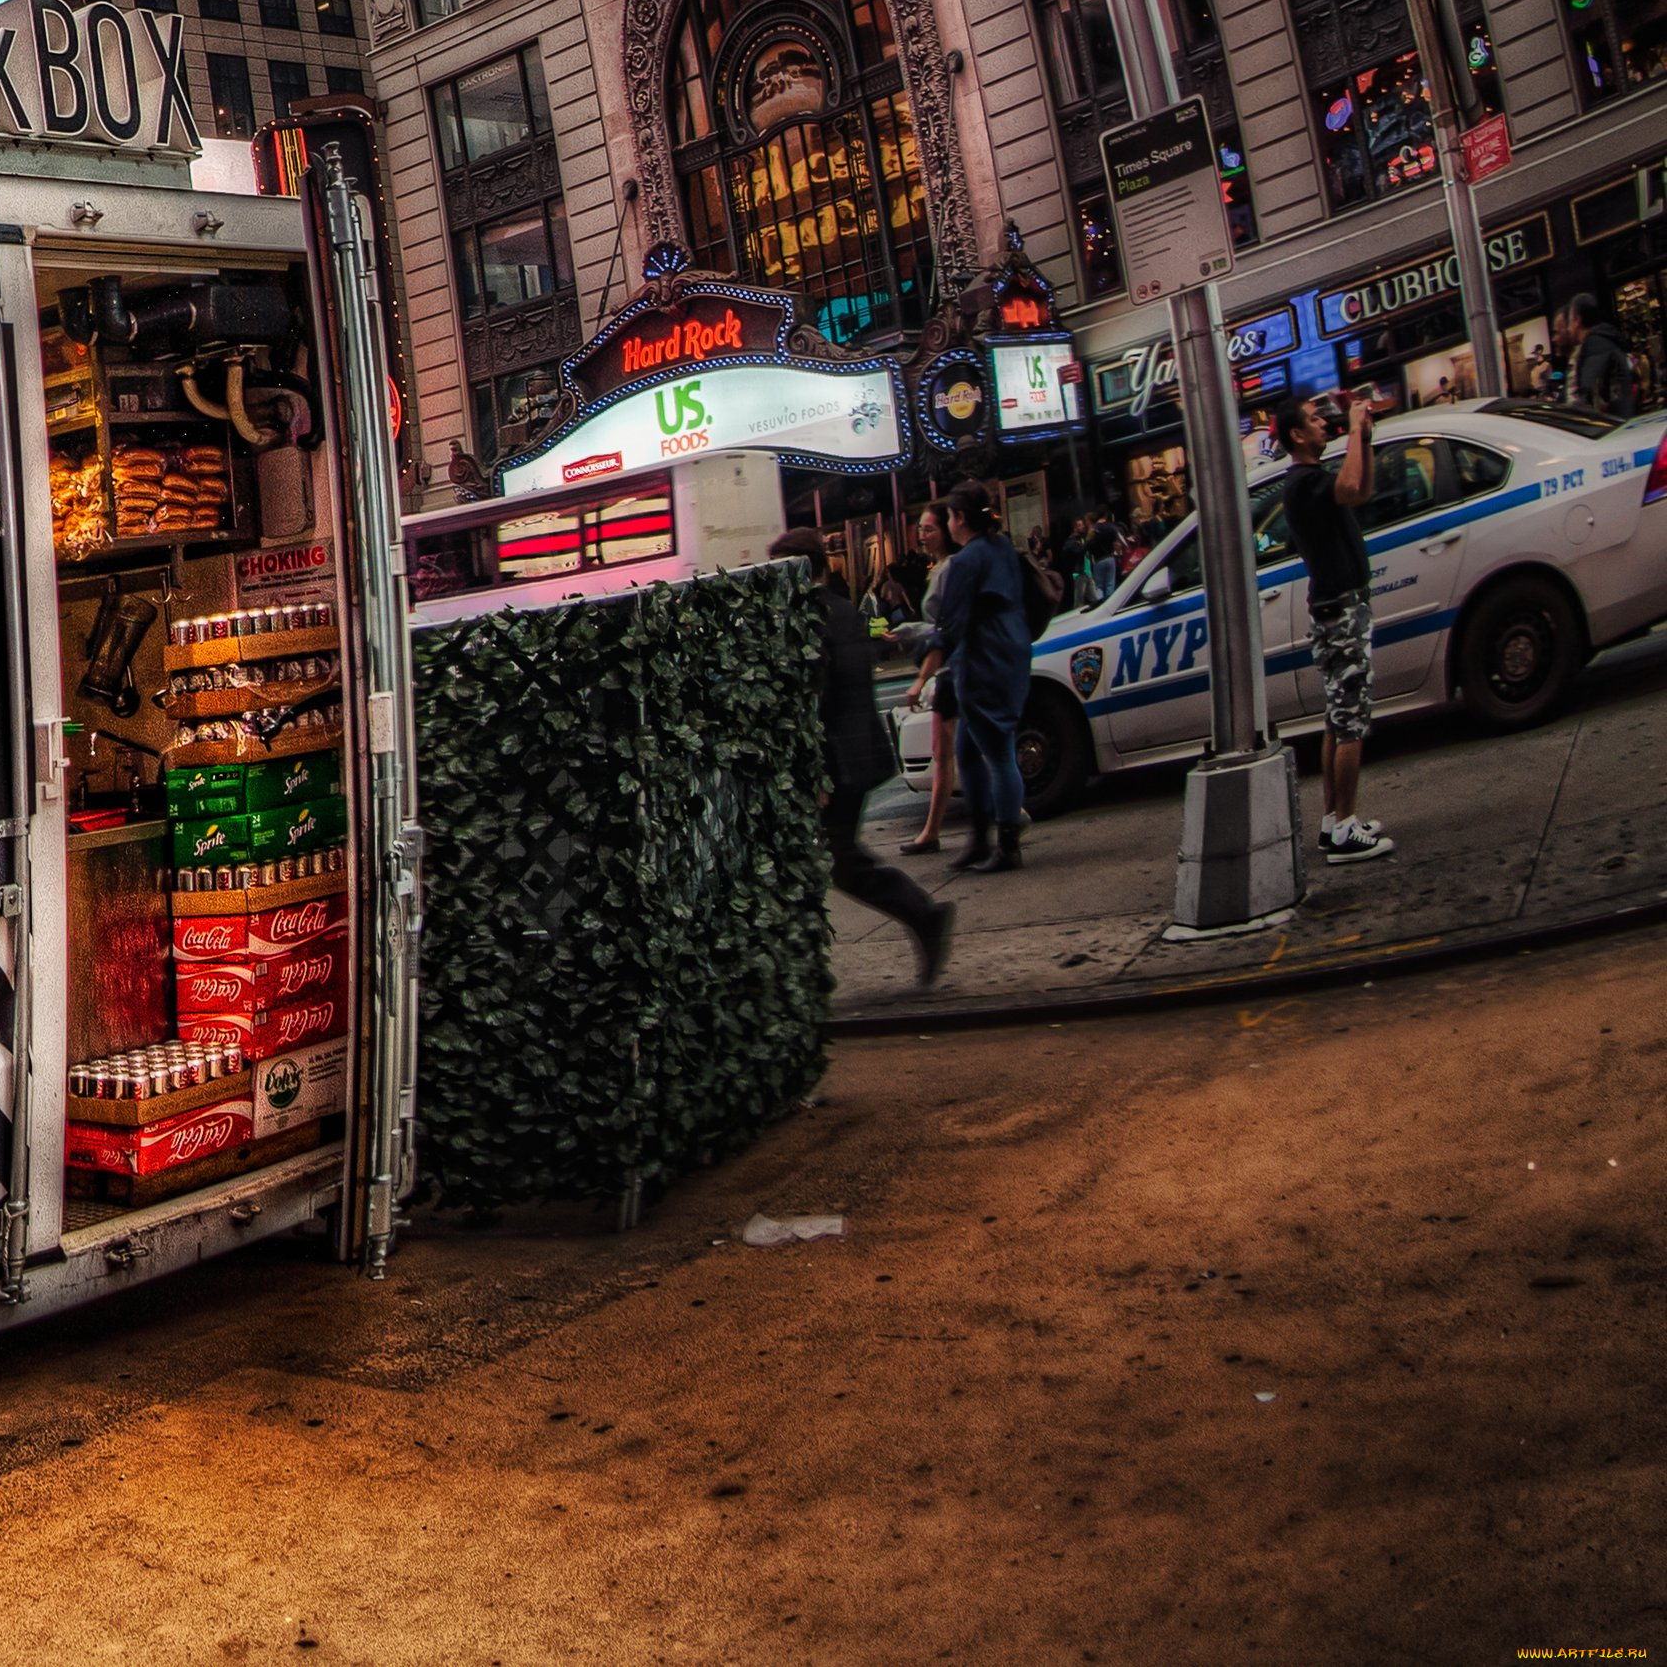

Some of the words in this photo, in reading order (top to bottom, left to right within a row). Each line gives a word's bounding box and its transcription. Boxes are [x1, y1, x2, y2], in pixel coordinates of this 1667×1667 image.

[1114, 157, 1149, 178] Times
[1151, 139, 1193, 163] Square
[1117, 175, 1150, 194] Plaza
[1339, 230, 1528, 324] CLUBHOSE
[623, 322, 681, 373] Hard
[684, 310, 743, 360] Rock
[935, 391, 960, 409] Hard
[748, 411, 797, 433] VESUVIO
[801, 401, 841, 422] FOODS
[660, 429, 709, 458] FOODS
[564, 458, 619, 480] CONNOISSEUR
[1562, 469, 1585, 492] PCT
[237, 545, 327, 578] CHOKING
[1112, 617, 1209, 686] NYP
[283, 769, 310, 795] Sprite
[194, 831, 226, 858] Sprite
[287, 818, 317, 845] Sprite
